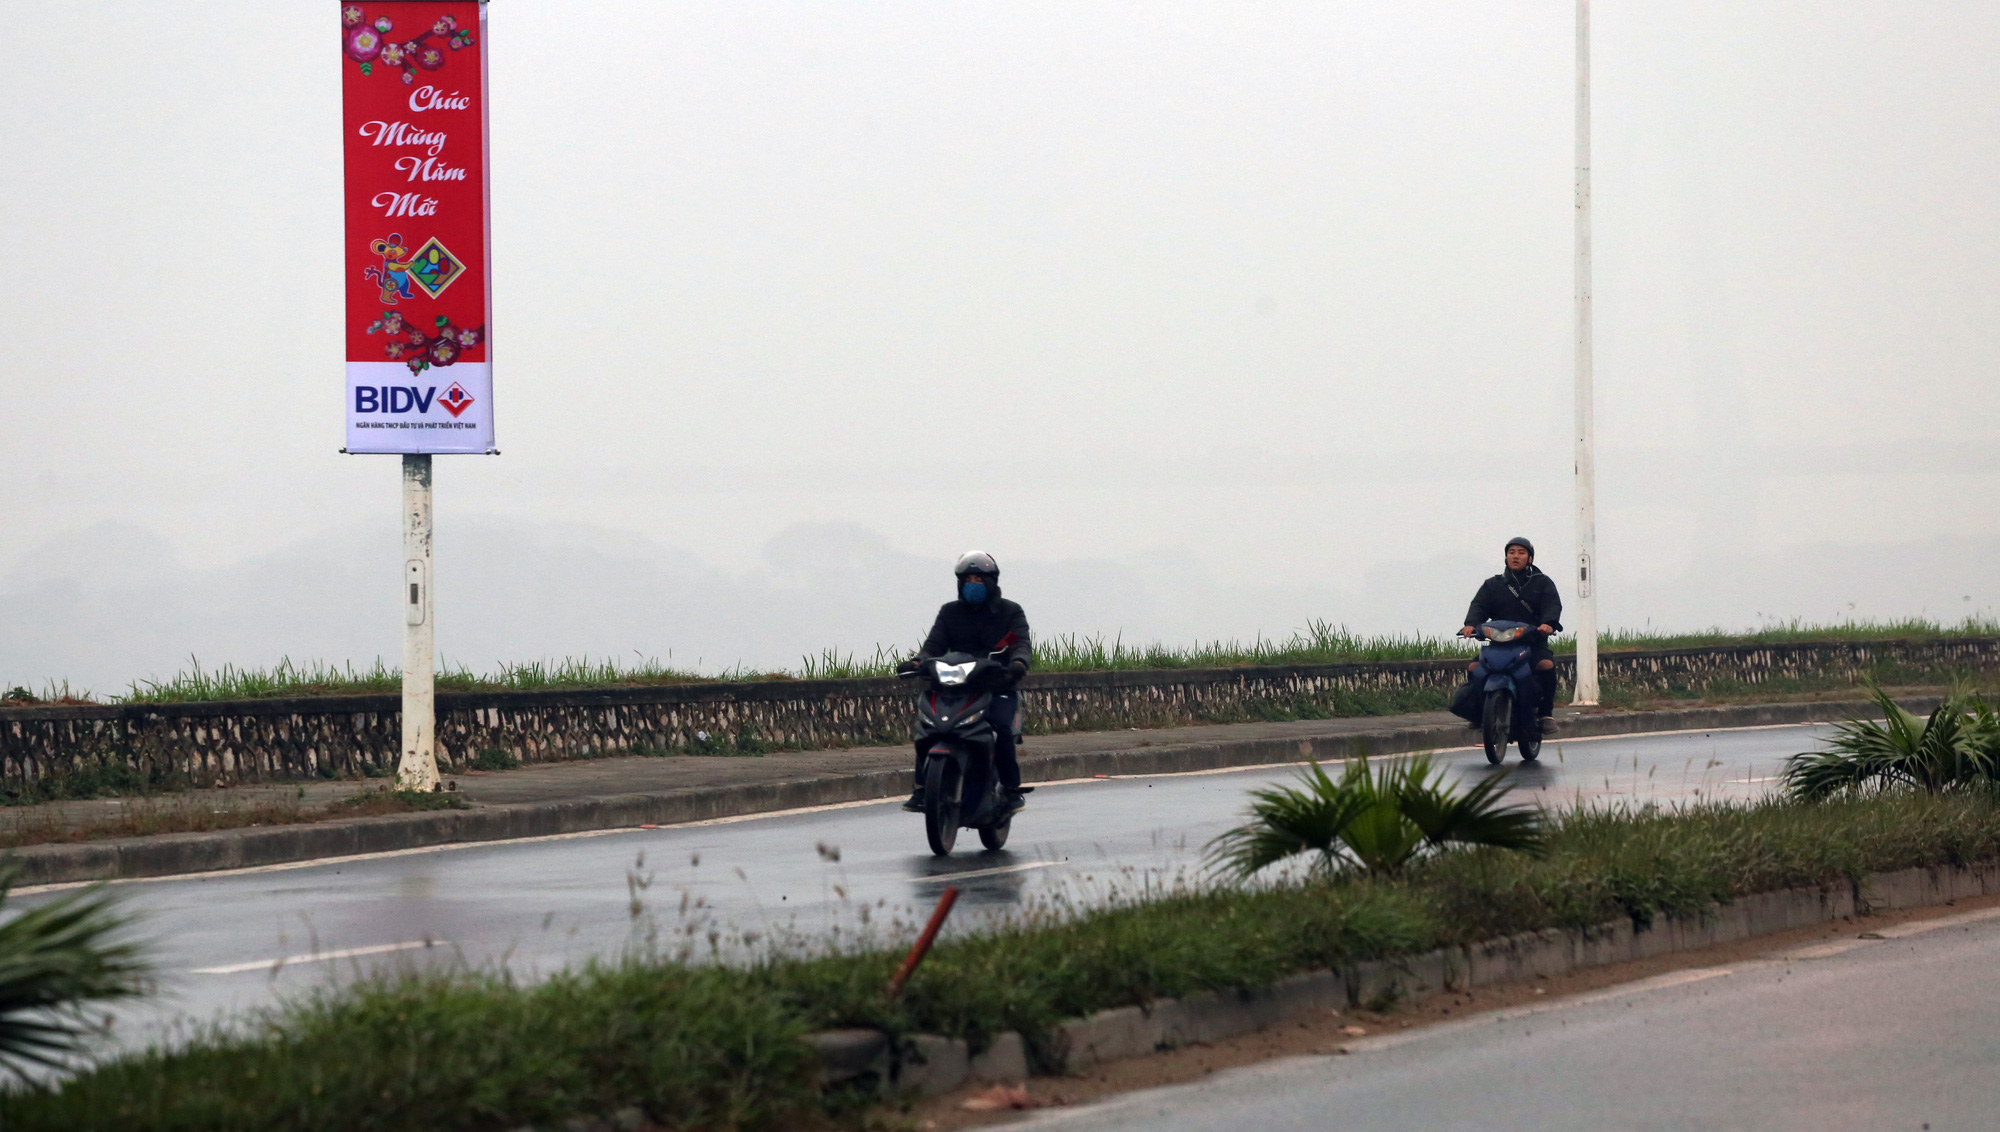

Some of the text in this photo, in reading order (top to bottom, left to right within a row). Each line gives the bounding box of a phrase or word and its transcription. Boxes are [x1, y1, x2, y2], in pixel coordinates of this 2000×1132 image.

[409, 85, 470, 112] Chúc
[359, 121, 447, 156] Mừng
[395, 157, 467, 182] Năm
[371, 191, 439, 217] Mới
[355, 386, 437, 413] BIDV
